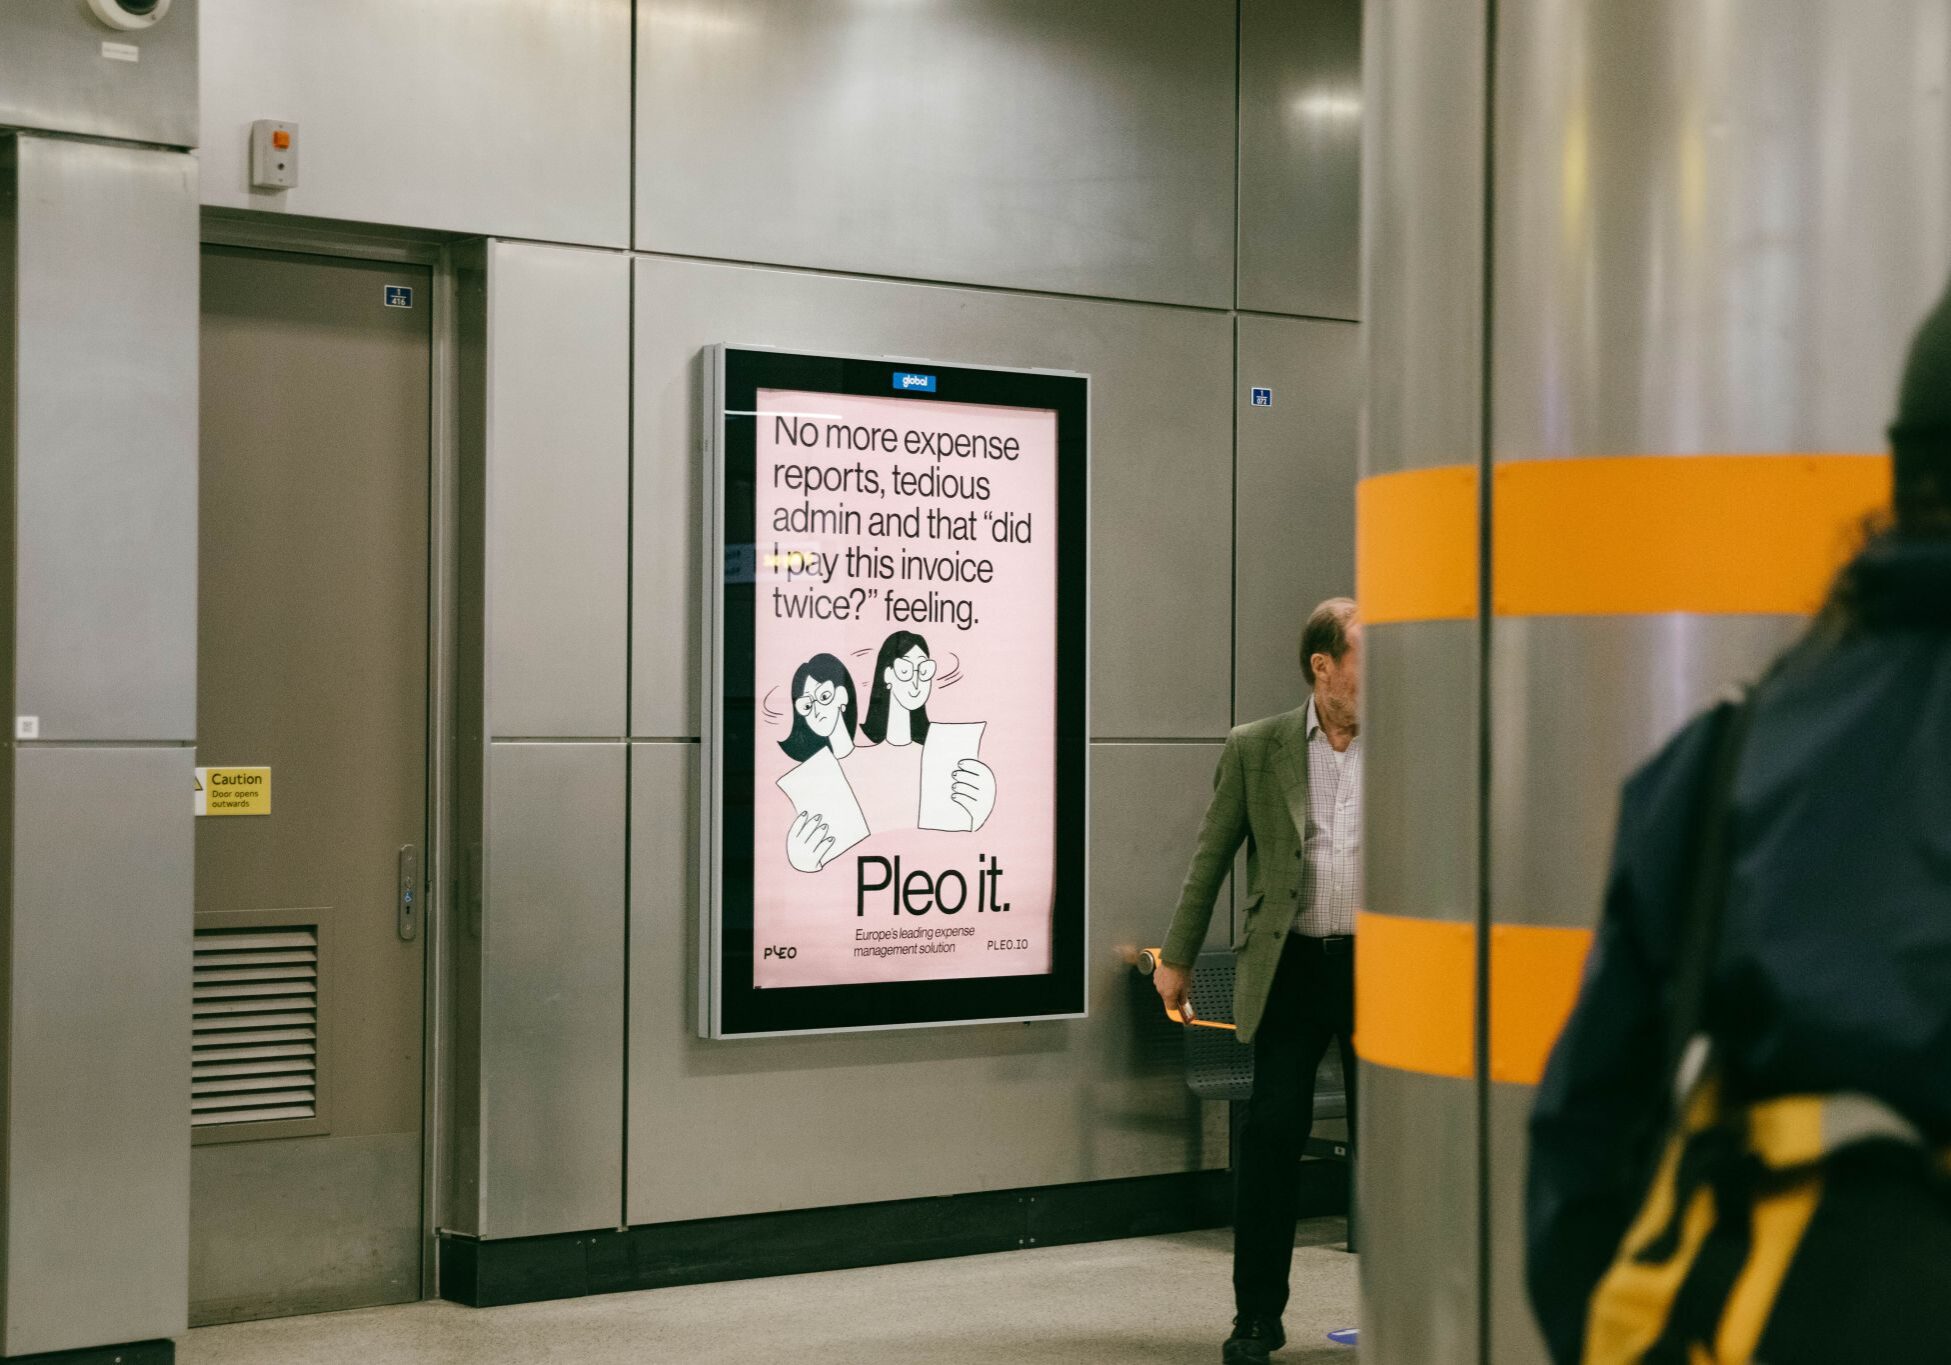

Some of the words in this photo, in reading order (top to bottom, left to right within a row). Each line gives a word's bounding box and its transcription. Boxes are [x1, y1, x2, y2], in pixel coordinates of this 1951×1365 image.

[391, 297, 406, 306] 416
[902, 374, 928, 388] global
[774, 414, 819, 448] No
[826, 422, 898, 452] more
[904, 428, 1020, 462] expense
[773, 462, 886, 498] reports,
[892, 465, 991, 501] tedious
[772, 501, 862, 536] admin
[868, 506, 921, 539] and
[926, 507, 978, 541] that
[983, 510, 1032, 544] “did
[774, 541, 779, 575] I
[787, 549, 839, 584] pay
[845, 546, 895, 580] this
[901, 548, 994, 583] invoice
[772, 586, 878, 621] twice?”
[884, 588, 979, 631] feeling.
[211, 772, 263, 786] Caution
[211, 790, 233, 798] Door
[234, 791, 260, 799] opens
[211, 800, 251, 808] outwards
[856, 855, 968, 917] Pleo
[977, 853, 1011, 914] it.
[855, 927, 899, 943] Europe's
[899, 926, 934, 941] leading
[934, 926, 976, 939] expense
[763, 945, 798, 960] PLEO
[853, 942, 918, 959] management
[918, 941, 956, 954] solution
[986, 938, 1029, 952] PLEO.IO
